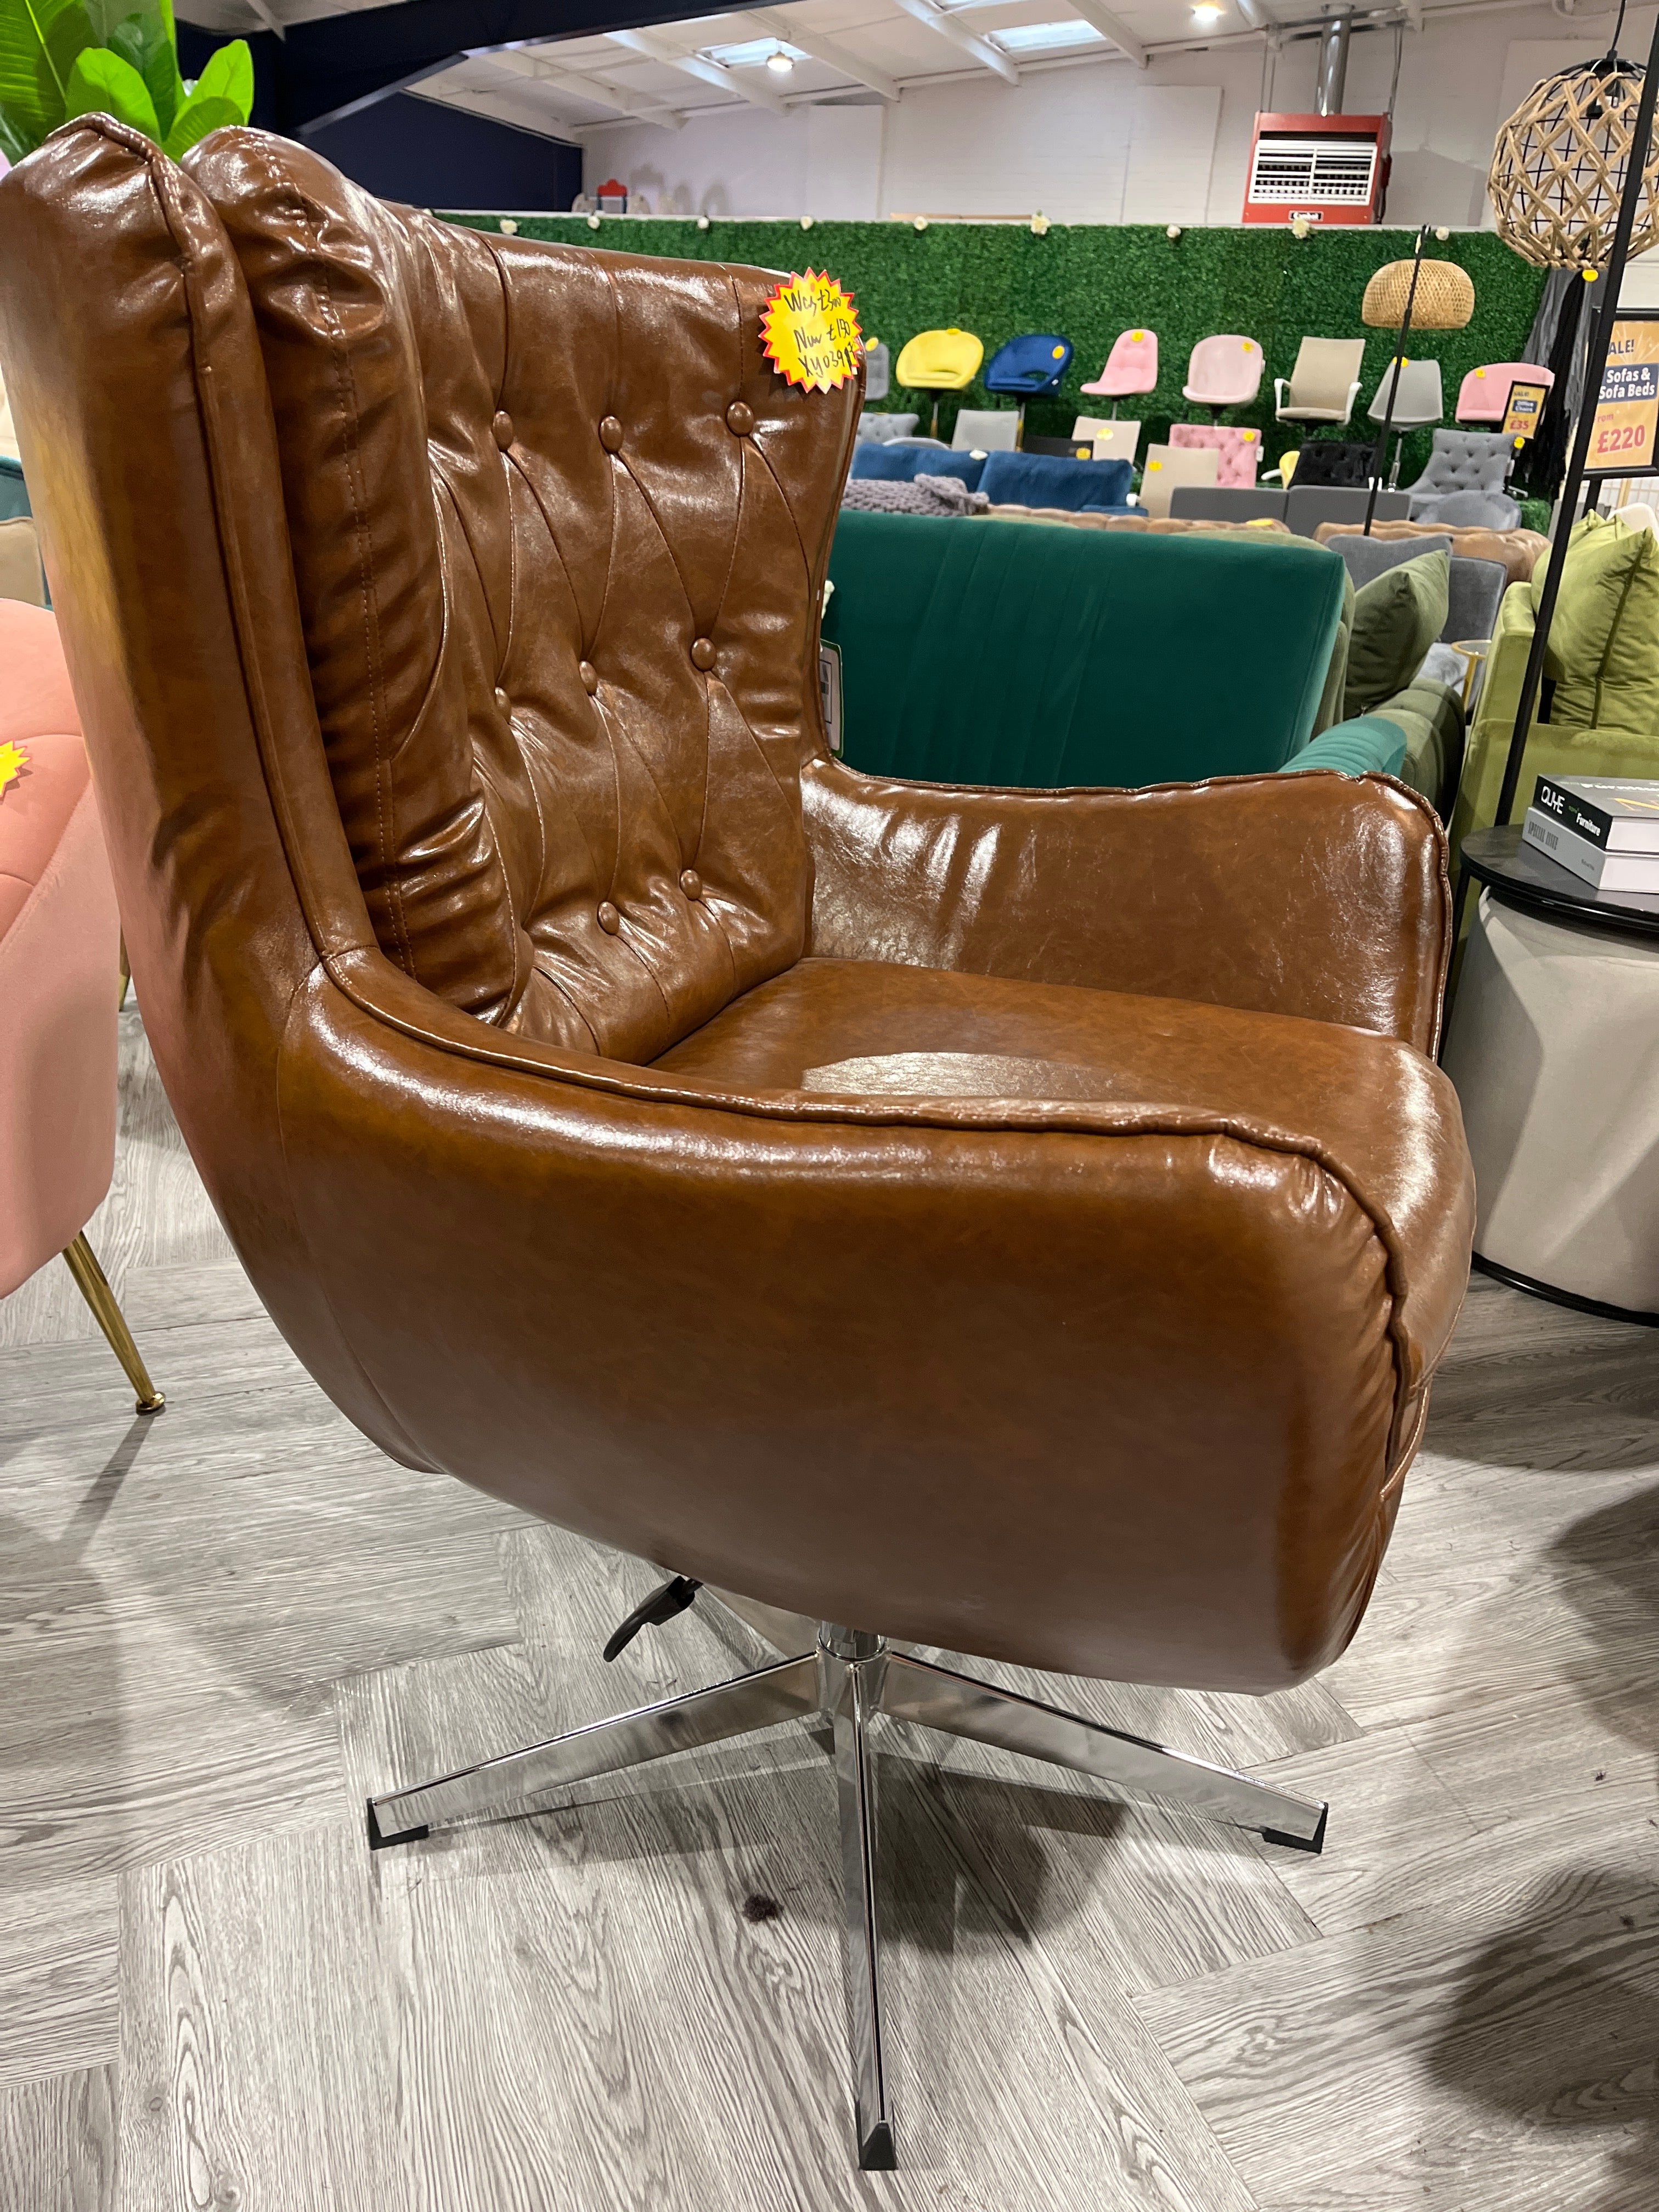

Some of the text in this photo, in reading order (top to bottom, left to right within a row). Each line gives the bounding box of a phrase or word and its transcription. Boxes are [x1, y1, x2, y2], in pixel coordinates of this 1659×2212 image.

[1607, 339, 1634, 356] ALE!
[1606, 367, 1650, 383] Sofas &
[1599, 382, 1655, 399] Sofa Beds
[1510, 420, 1528, 430] £35
[1597, 425, 1645, 453] £220
[1576, 812, 1601, 836] Furniture
